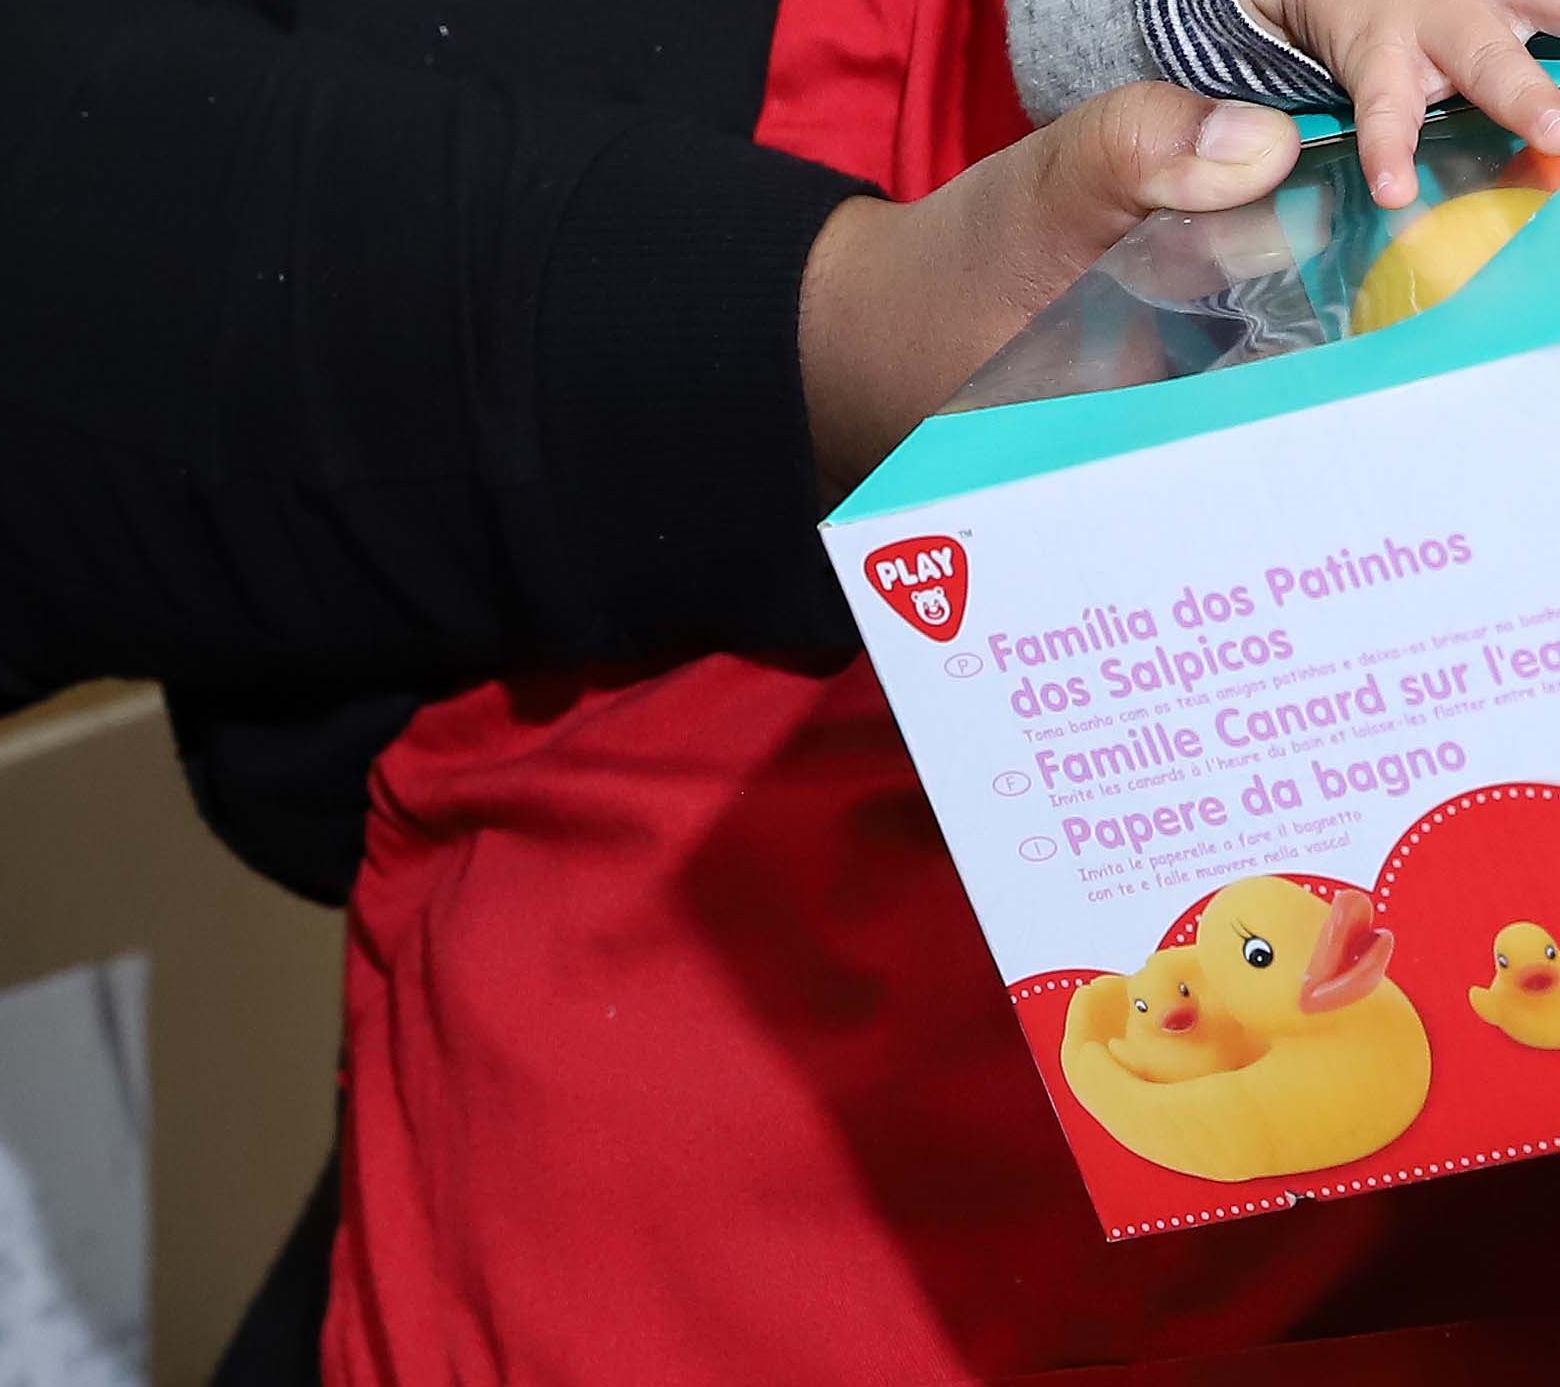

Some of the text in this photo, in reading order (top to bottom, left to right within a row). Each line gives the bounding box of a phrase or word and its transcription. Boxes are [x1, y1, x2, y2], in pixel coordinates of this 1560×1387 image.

[876, 547, 953, 590] PLAY
[988, 605, 1158, 672] Família
[1172, 586, 1254, 629] dos
[1265, 534, 1472, 607] Patinhos
[1011, 630, 1293, 718] dos Salpicos
[1021, 726, 1065, 743] Toma
[1118, 707, 1150, 724] com
[1215, 679, 1267, 700] amigos
[1035, 723, 1203, 789] Famille
[1215, 673, 1386, 748] Canard
[1400, 663, 1467, 705] sur
[1047, 788, 1095, 808] Invite
[1098, 783, 1122, 796] les
[1127, 766, 1186, 792] canards
[1267, 743, 1287, 760] du
[1062, 797, 1227, 870] Papere
[1242, 774, 1302, 816] da
[1312, 741, 1466, 800] bagno
[1077, 863, 1125, 882] Invita
[1127, 856, 1144, 871] le
[1087, 888, 1114, 903] con
[1117, 882, 1136, 896] te
